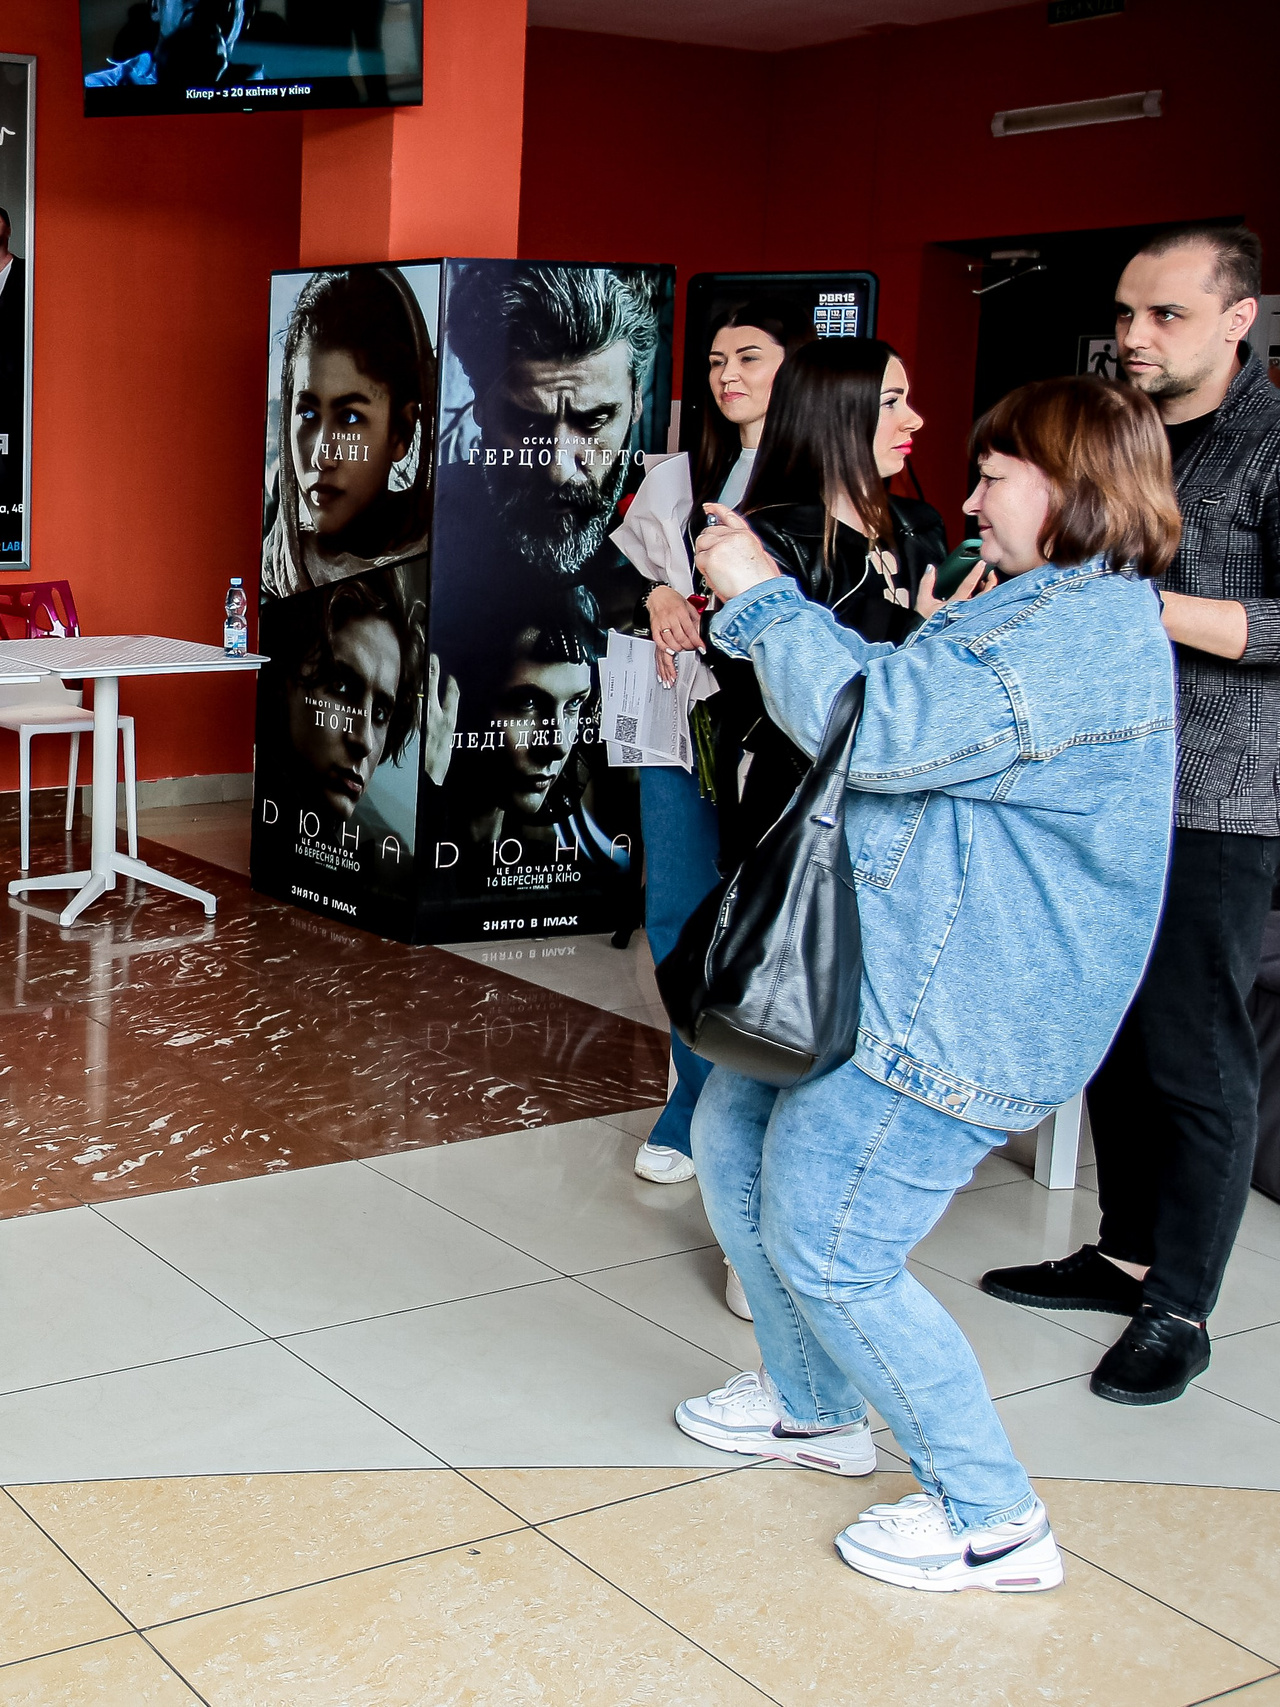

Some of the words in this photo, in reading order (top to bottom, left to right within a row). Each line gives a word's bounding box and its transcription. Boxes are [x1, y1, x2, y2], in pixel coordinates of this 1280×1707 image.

[186, 88, 214, 99] Кілер
[231, 87, 243, 97] 20
[245, 86, 278, 97] квітня
[280, 87, 287, 99] у
[289, 85, 311, 96] кіно
[819, 293, 855, 302] DBR15
[332, 432, 361, 441] ЗЕНДЕЯ
[522, 436, 560, 445] ОСКАР
[566, 435, 600, 445] АЙЗЕК
[321, 443, 369, 462] ЧАНІ
[468, 448, 568, 469] ГЕРЦОГ
[581, 449, 645, 466] ЛЕТО
[11, 503, 23, 513] 48
[2, 541, 22, 552] LAB
[305, 696, 331, 709] ТІМОТІ
[334, 703, 368, 717] ШАЛАМЕ
[315, 710, 353, 734] ПОЛ
[491, 719, 536, 728] РЕБЕККА
[449, 731, 506, 751] ЛЕДІ
[301, 837, 311, 846] ЦЕ
[315, 841, 354, 859] ПОЧАТОК
[295, 843, 303, 855] 16
[304, 847, 334, 864] ВЕРЕСНЯ
[335, 855, 340, 866] В
[341, 857, 361, 872] КІНО
[497, 867, 510, 876] ЦЕ
[517, 864, 572, 875] ПОЧАТОК
[486, 876, 498, 887] 16
[501, 874, 545, 886] ВЕРЕСНЯ
[547, 873, 553, 883] В
[555, 871, 581, 883] КІНО
[291, 885, 319, 902] ЗНЯТО
[323, 896, 328, 905] В
[331, 899, 357, 916] IMAX
[482, 918, 525, 931] ЗНЯТО
[530, 918, 538, 928] В
[543, 915, 578, 927] IMAX
